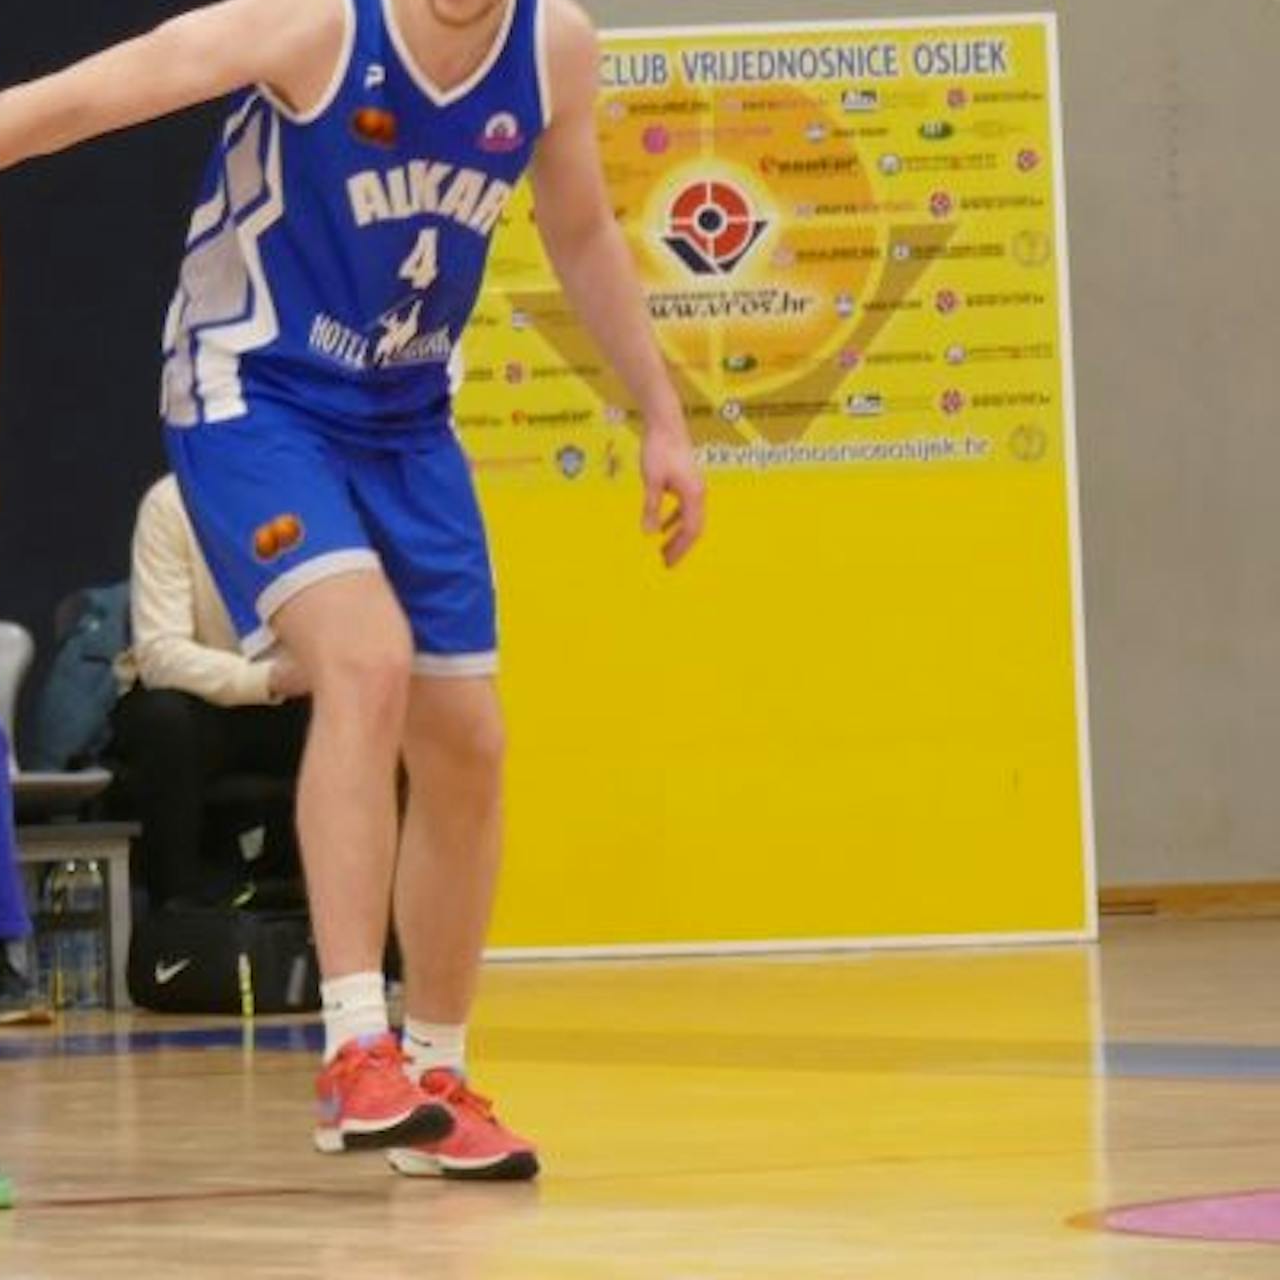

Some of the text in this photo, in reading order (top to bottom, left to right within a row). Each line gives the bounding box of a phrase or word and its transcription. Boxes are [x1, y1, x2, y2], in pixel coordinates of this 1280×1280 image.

[680, 45, 898, 83] VRIJEDNOSNICE
[914, 40, 1007, 75] OSIJEK
[347, 158, 512, 236] ALKAR
[399, 227, 438, 290] 4
